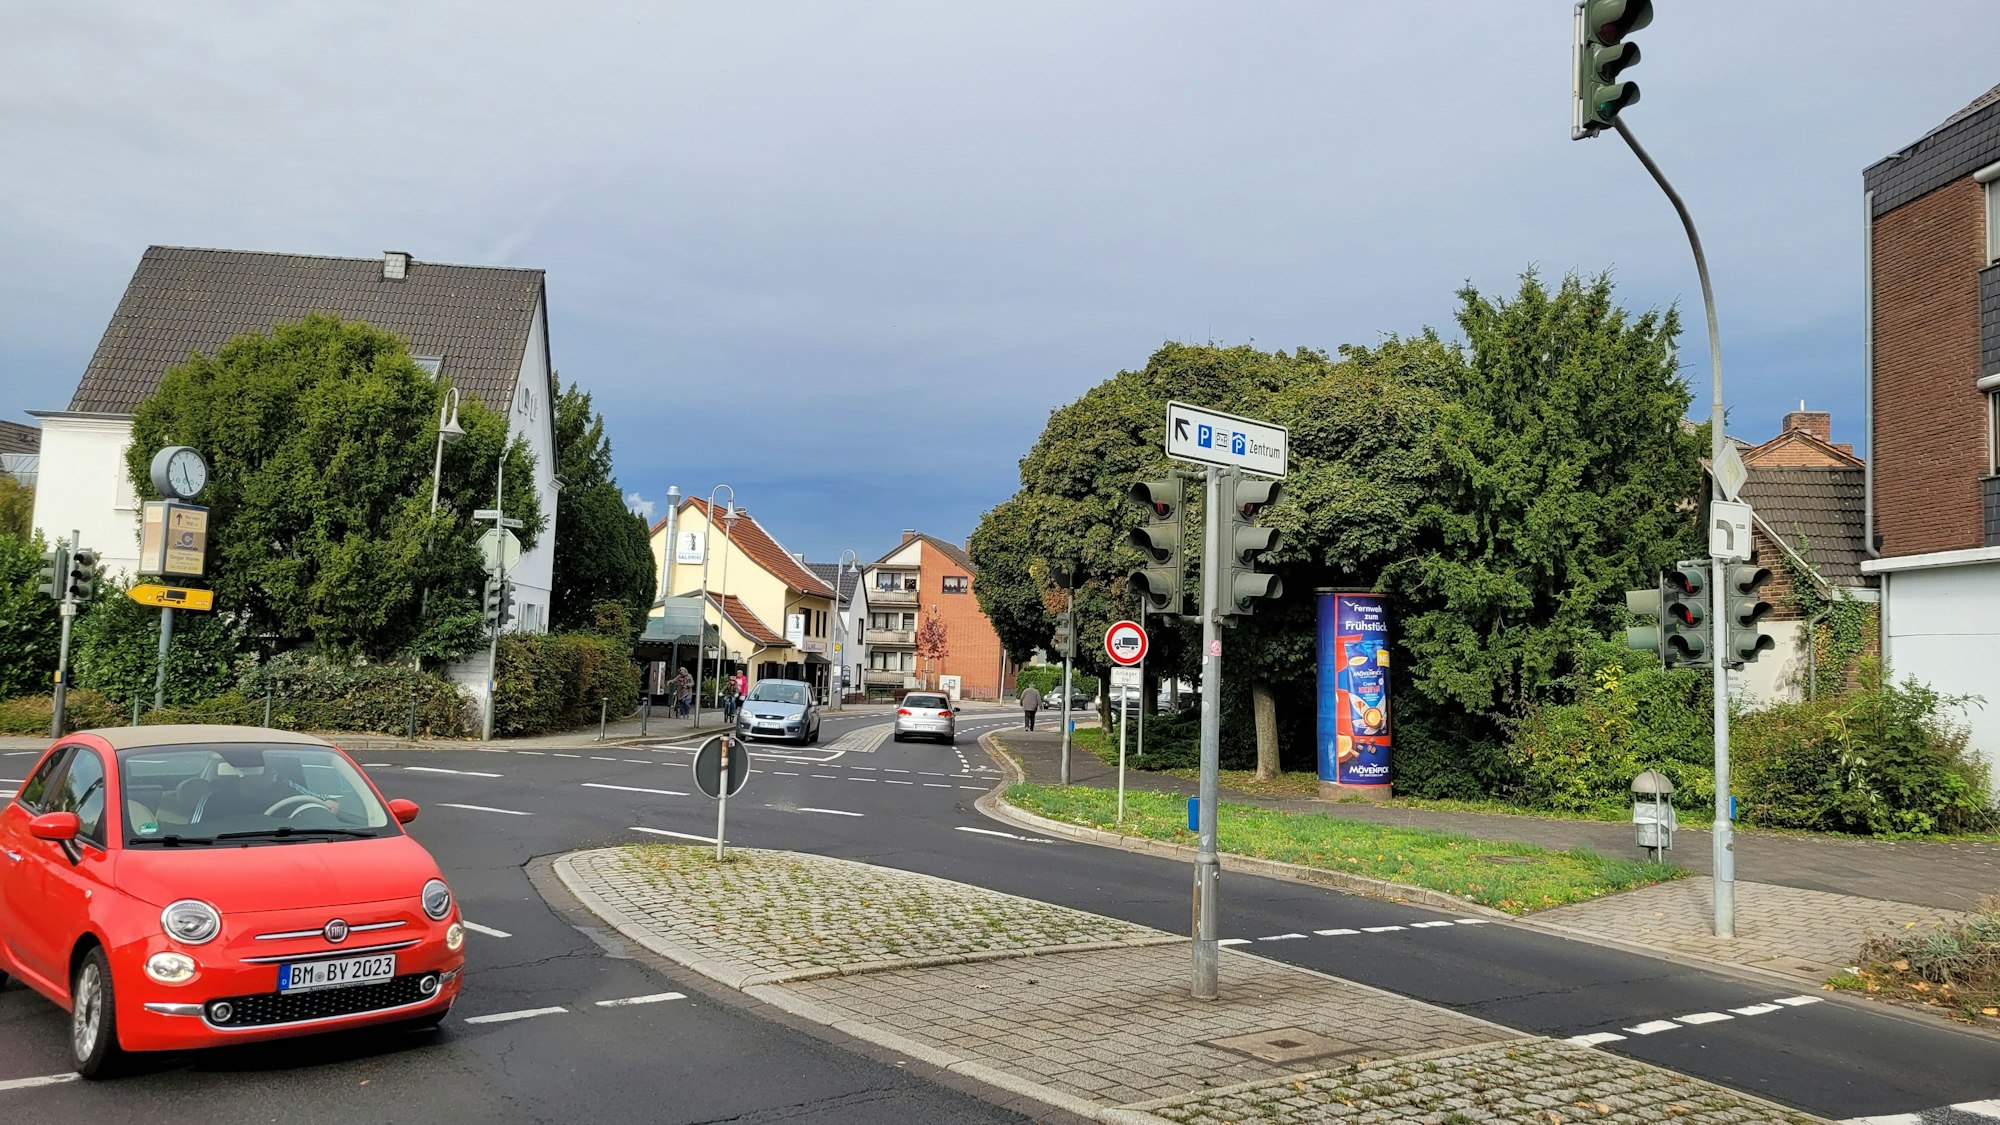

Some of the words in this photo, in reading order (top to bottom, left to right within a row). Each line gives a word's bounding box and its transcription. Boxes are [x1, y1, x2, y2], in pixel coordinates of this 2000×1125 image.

[1200, 428, 1209, 445] P
[1235, 439, 1243, 453] P
[1249, 439, 1281, 459] Zentrum
[1353, 604, 1383, 613] Fernweh
[331, 926, 344, 937] FIAT
[291, 965, 314, 986] BM
[326, 961, 349, 982] BY
[352, 957, 393, 979] 2023
